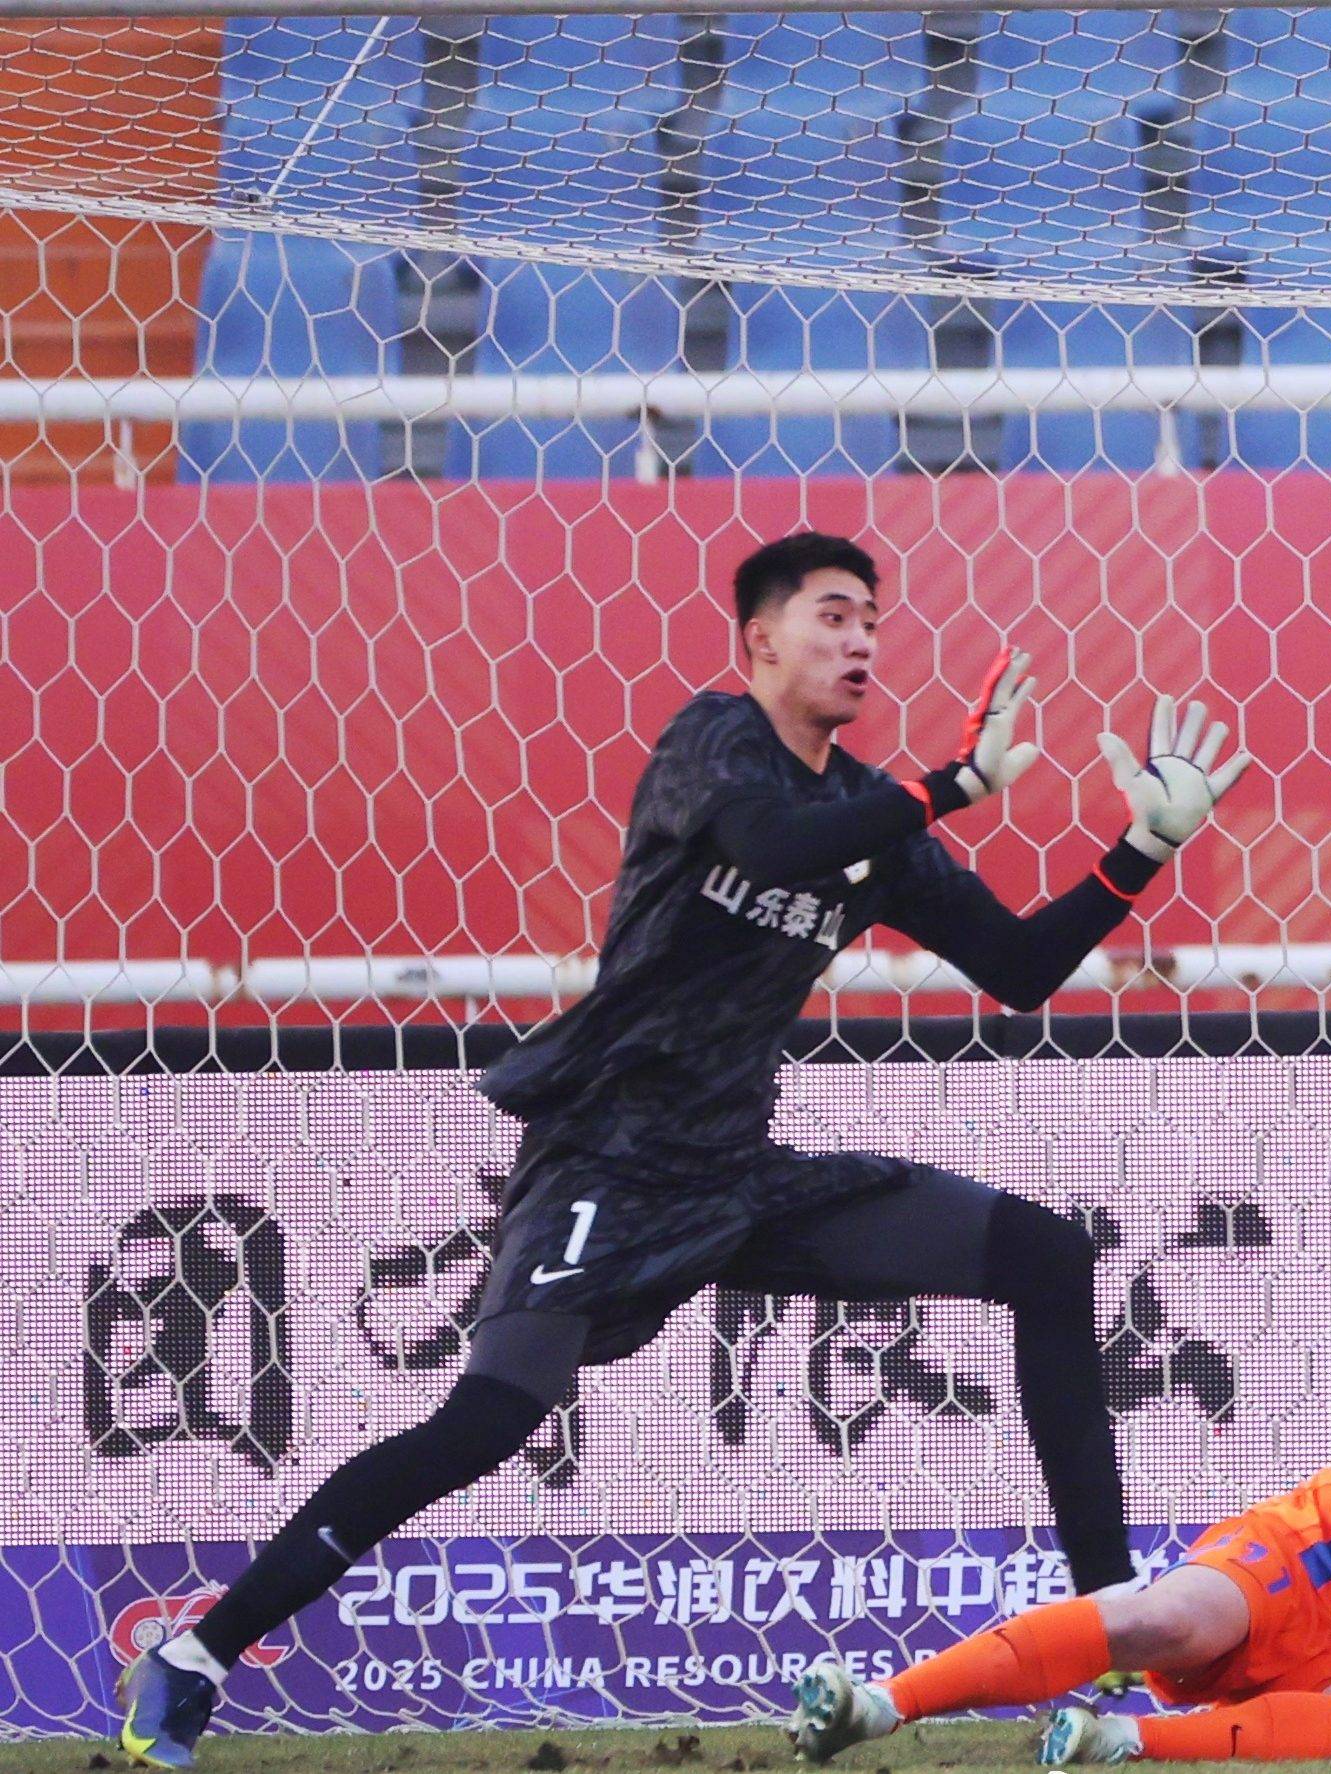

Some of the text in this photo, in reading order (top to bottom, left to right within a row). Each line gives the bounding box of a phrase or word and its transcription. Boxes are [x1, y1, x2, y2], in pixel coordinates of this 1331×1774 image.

[700, 865, 845, 951] 山东泰山
[563, 1200, 598, 1266] 1
[338, 1549, 1190, 1626] 2025华润饮料中超
[335, 1658, 442, 1692] 2025
[462, 1656, 603, 1689] CHINA
